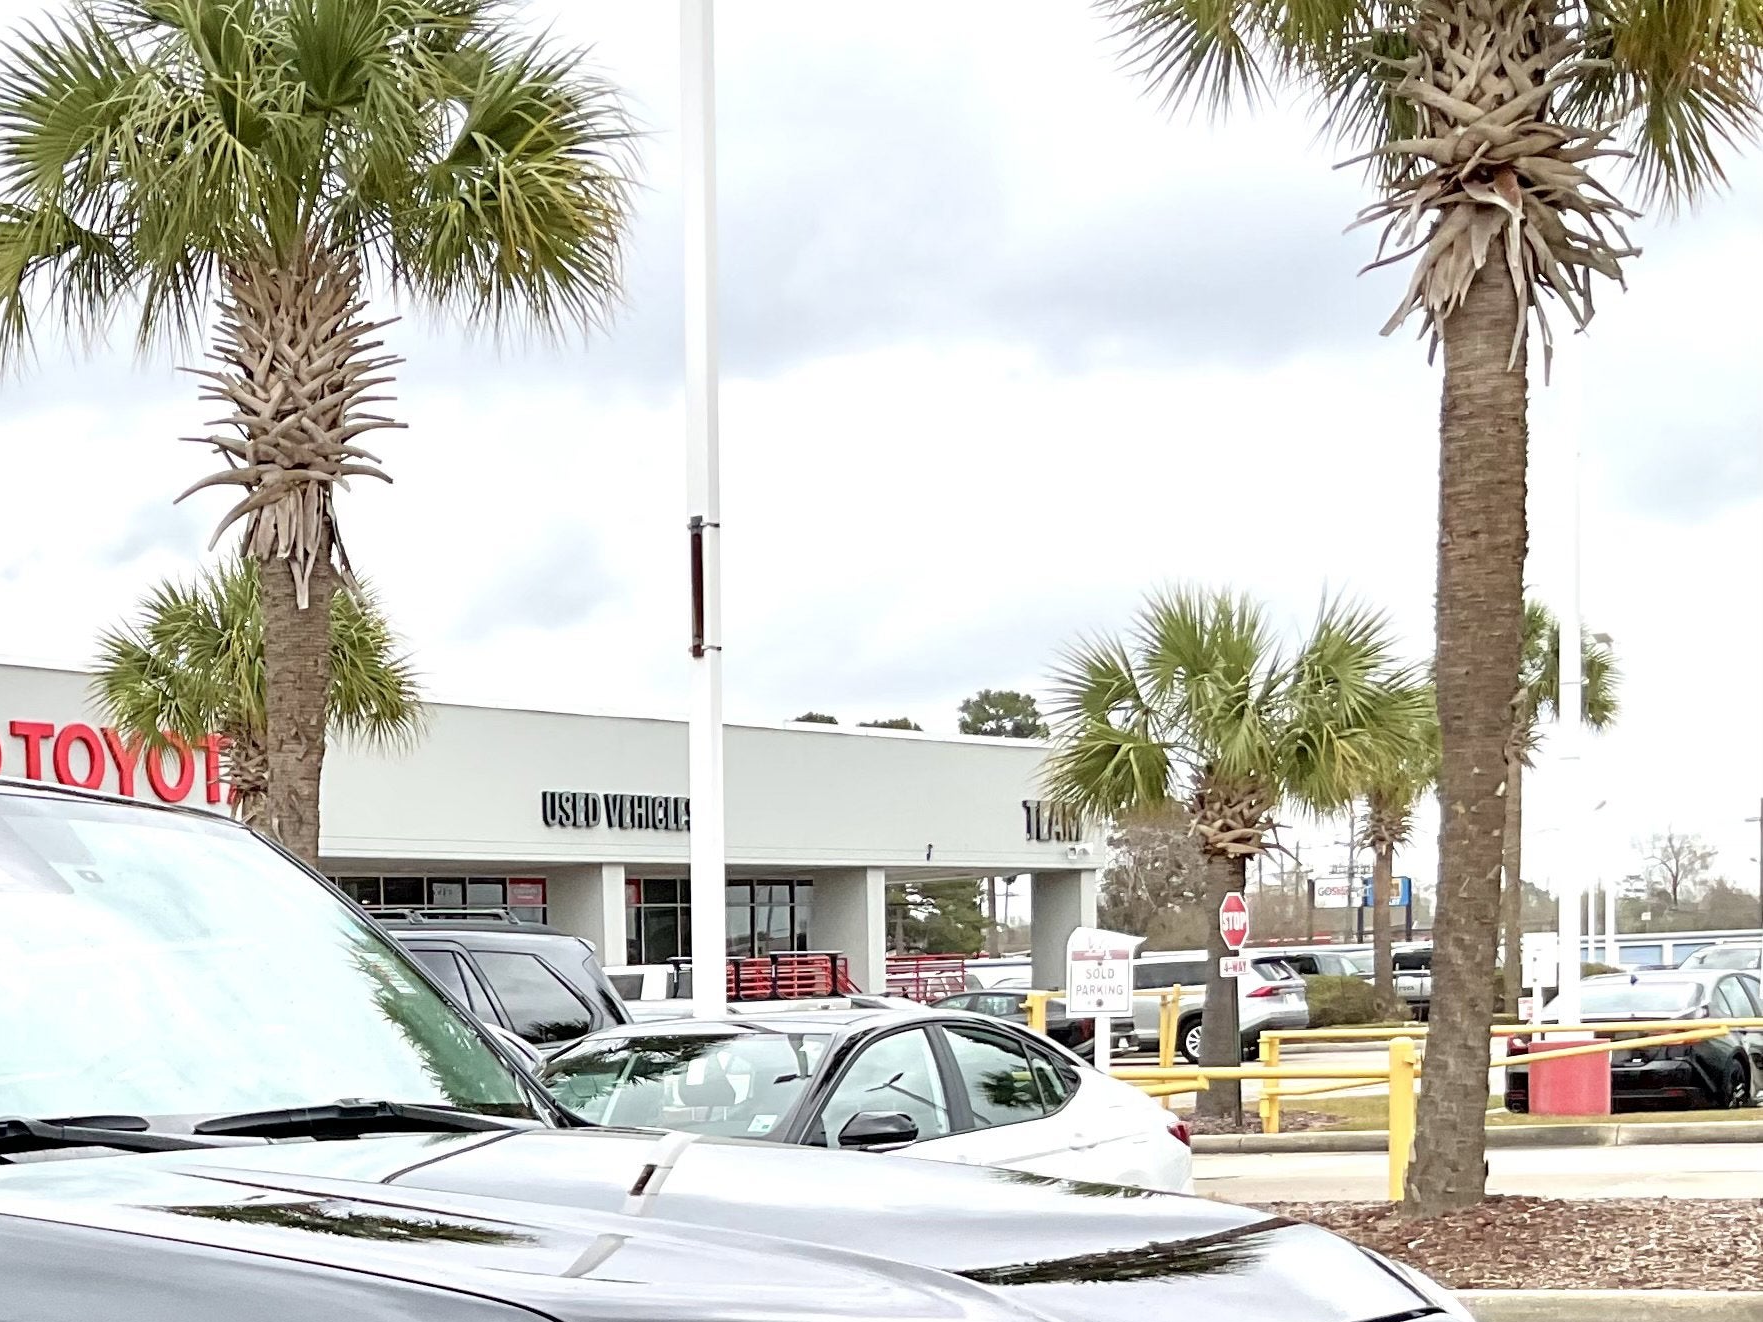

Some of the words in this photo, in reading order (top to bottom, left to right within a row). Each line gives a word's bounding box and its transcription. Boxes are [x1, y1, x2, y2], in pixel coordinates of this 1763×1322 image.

[541, 790, 601, 829] USED
[602, 793, 691, 835] VEHICLE
[1222, 911, 1247, 931] STOP
[1224, 961, 1247, 973] 4-WAY
[1085, 968, 1115, 979] SOLD
[1076, 984, 1124, 996] PARKING
